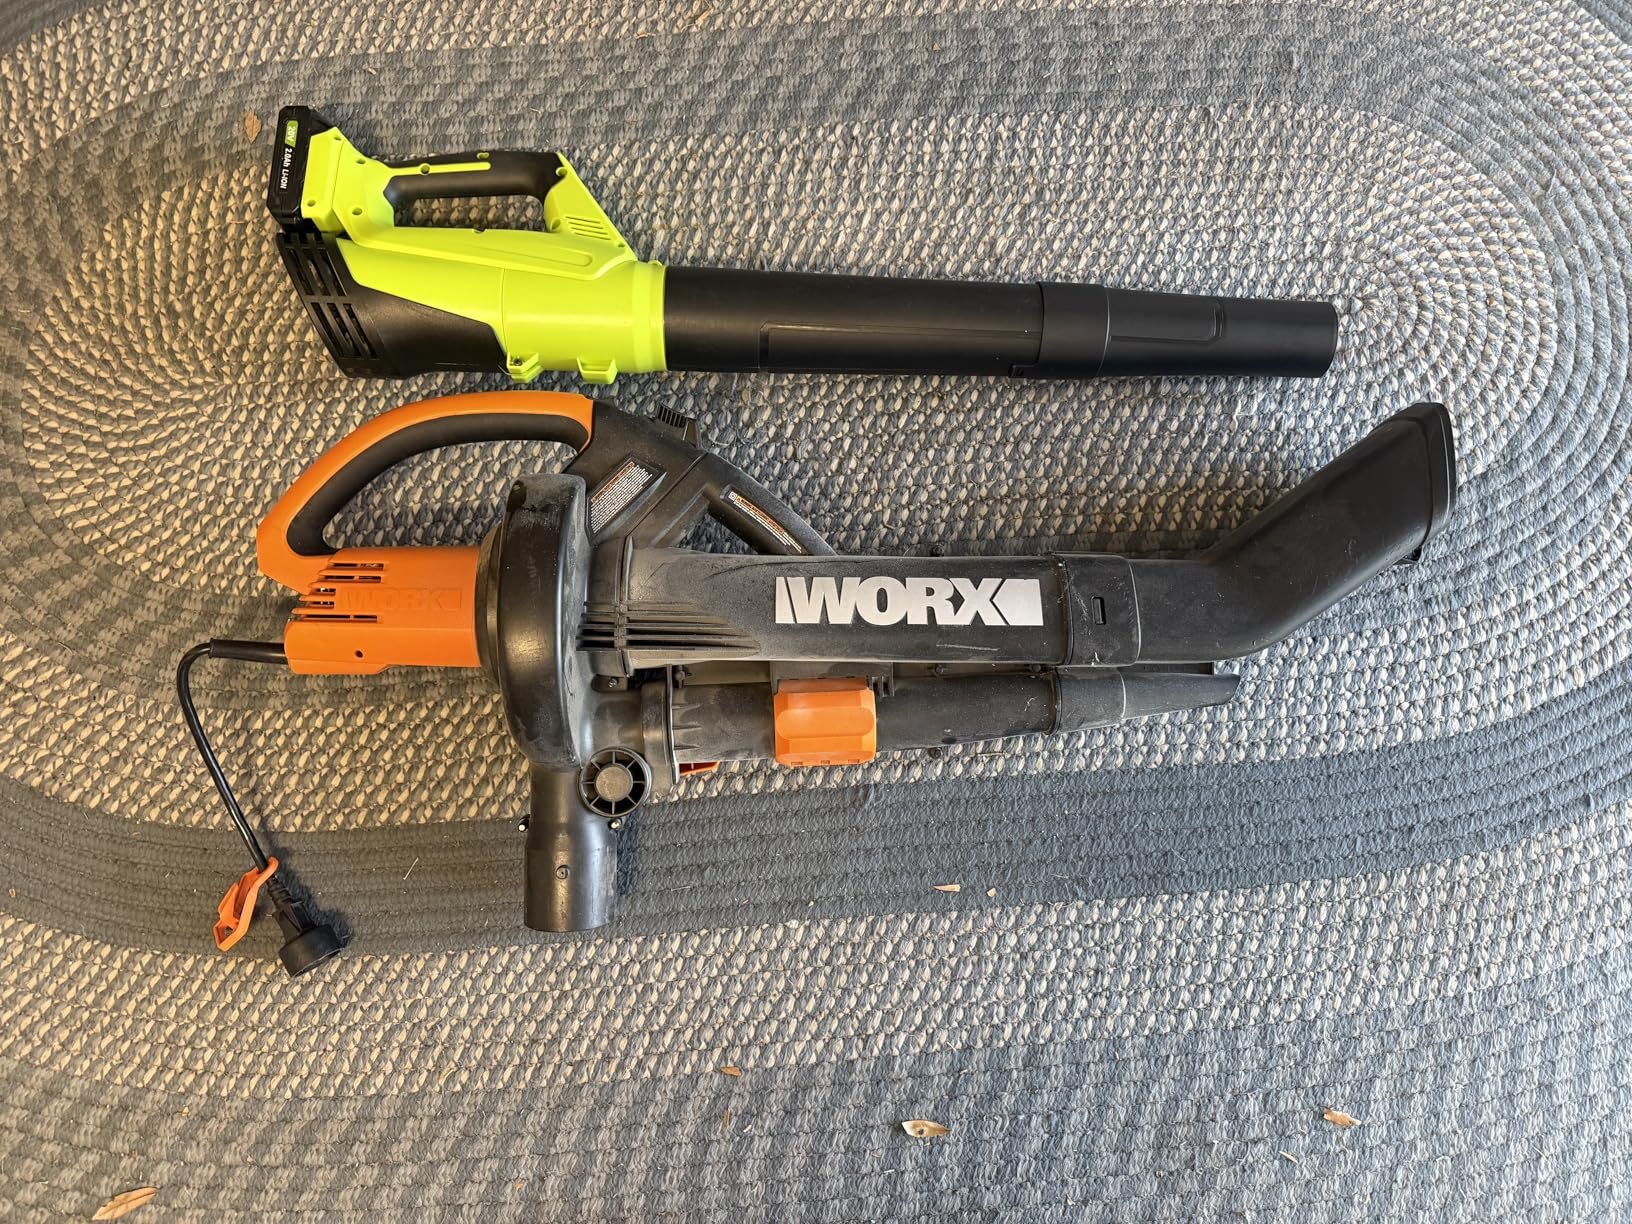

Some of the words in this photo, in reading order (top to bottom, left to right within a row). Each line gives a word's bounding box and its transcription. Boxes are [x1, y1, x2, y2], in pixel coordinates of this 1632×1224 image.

[287, 126, 295, 142] 20V
[283, 148, 292, 167] 2.0Ah
[784, 576, 1012, 627] WORX
